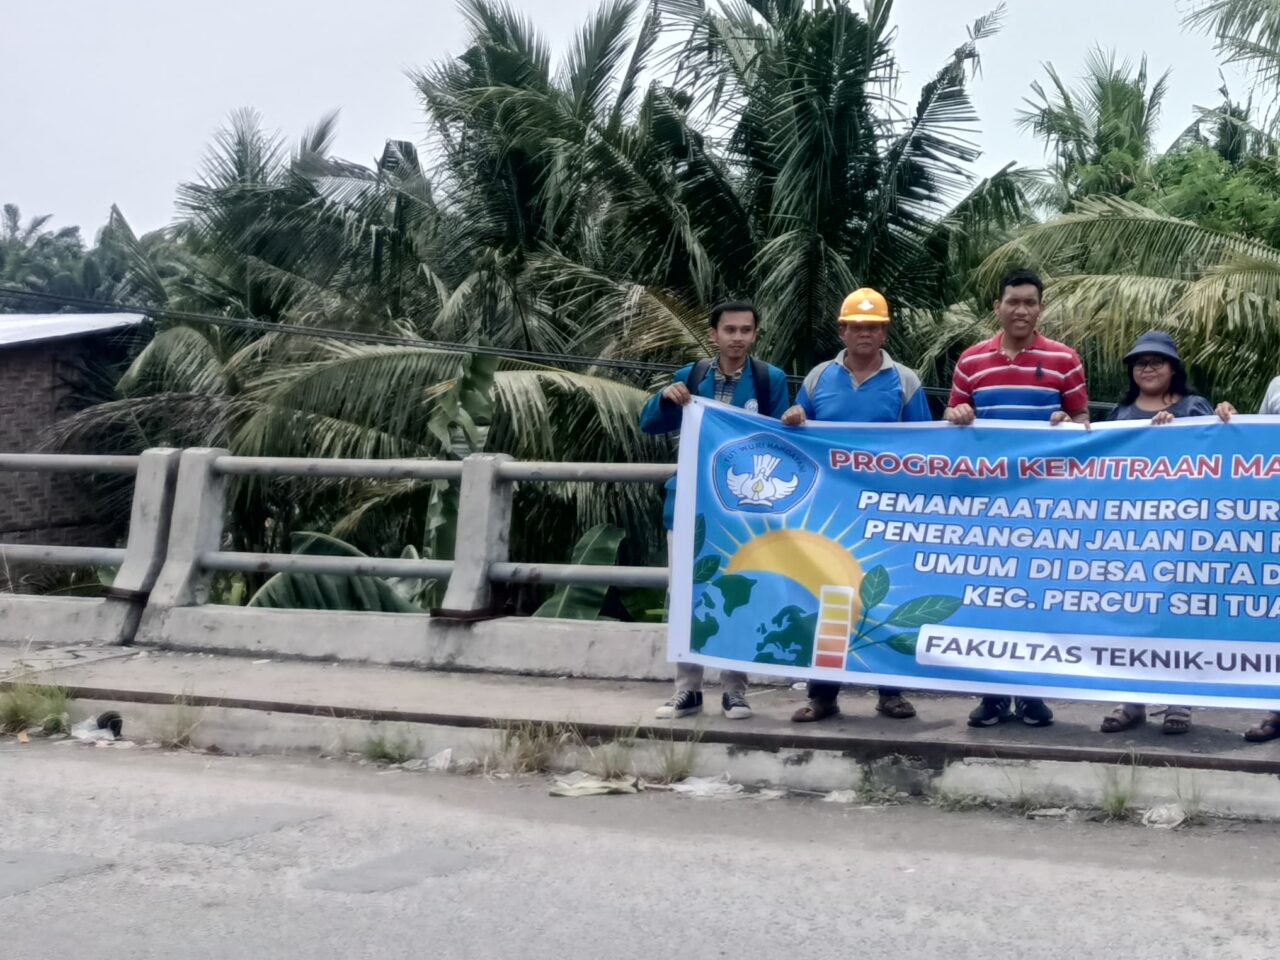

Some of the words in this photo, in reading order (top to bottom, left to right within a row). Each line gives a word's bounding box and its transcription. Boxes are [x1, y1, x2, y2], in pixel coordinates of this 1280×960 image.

[829, 448, 1007, 478] PROGRAM
[1018, 454, 1221, 479] KEMITRAAN
[858, 491, 1098, 519] PEMANFAATAN
[1103, 499, 1209, 521] ENERGI
[863, 519, 1081, 550] PENERANGAN
[1085, 529, 1185, 552] JALAN
[1191, 530, 1264, 553] DAN
[914, 552, 1018, 577] UMUM
[1028, 559, 1063, 580] DI
[1067, 560, 1147, 582] DESA
[1152, 561, 1256, 585] CINTA
[963, 585, 1036, 610] KEC.
[1043, 591, 1164, 614] PERCUT
[1168, 592, 1218, 616] SEI
[924, 635, 1083, 664] FAKULTAS
